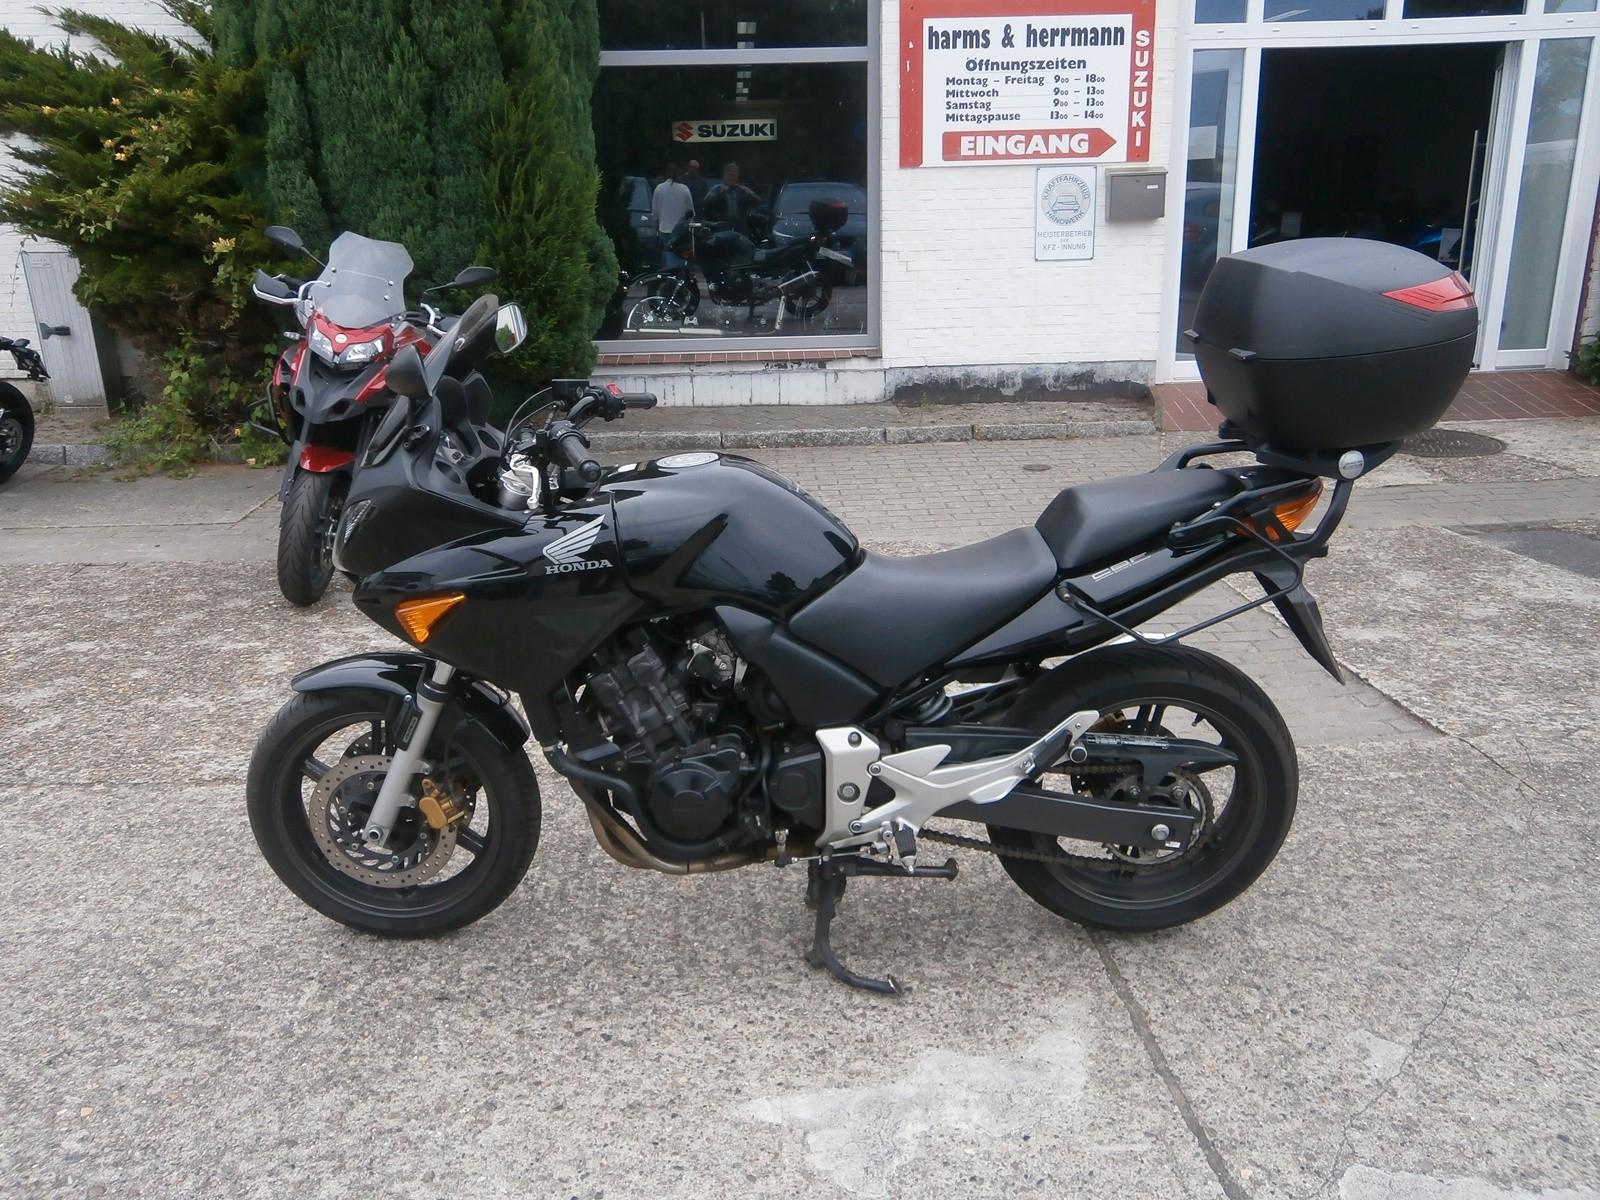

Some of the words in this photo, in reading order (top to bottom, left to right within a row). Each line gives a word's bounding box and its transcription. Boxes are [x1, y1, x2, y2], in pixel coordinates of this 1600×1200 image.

[928, 25, 990, 50] harms
[1001, 24, 1014, 48] &
[1026, 23, 1125, 48] herrmann
[965, 56, 1087, 73] Öffnungszeiten
[945, 76, 988, 87] Montag
[1004, 75, 1045, 86] Freitag
[1131, 29, 1151, 147] SUZUKI
[945, 88, 999, 98] Mittwoch
[945, 101, 992, 111] Samstag
[945, 112, 1021, 124] Mittagspause
[697, 122, 775, 138] SUZUKI
[959, 133, 1089, 156] EINGANG
[544, 559, 613, 575] HONDA
